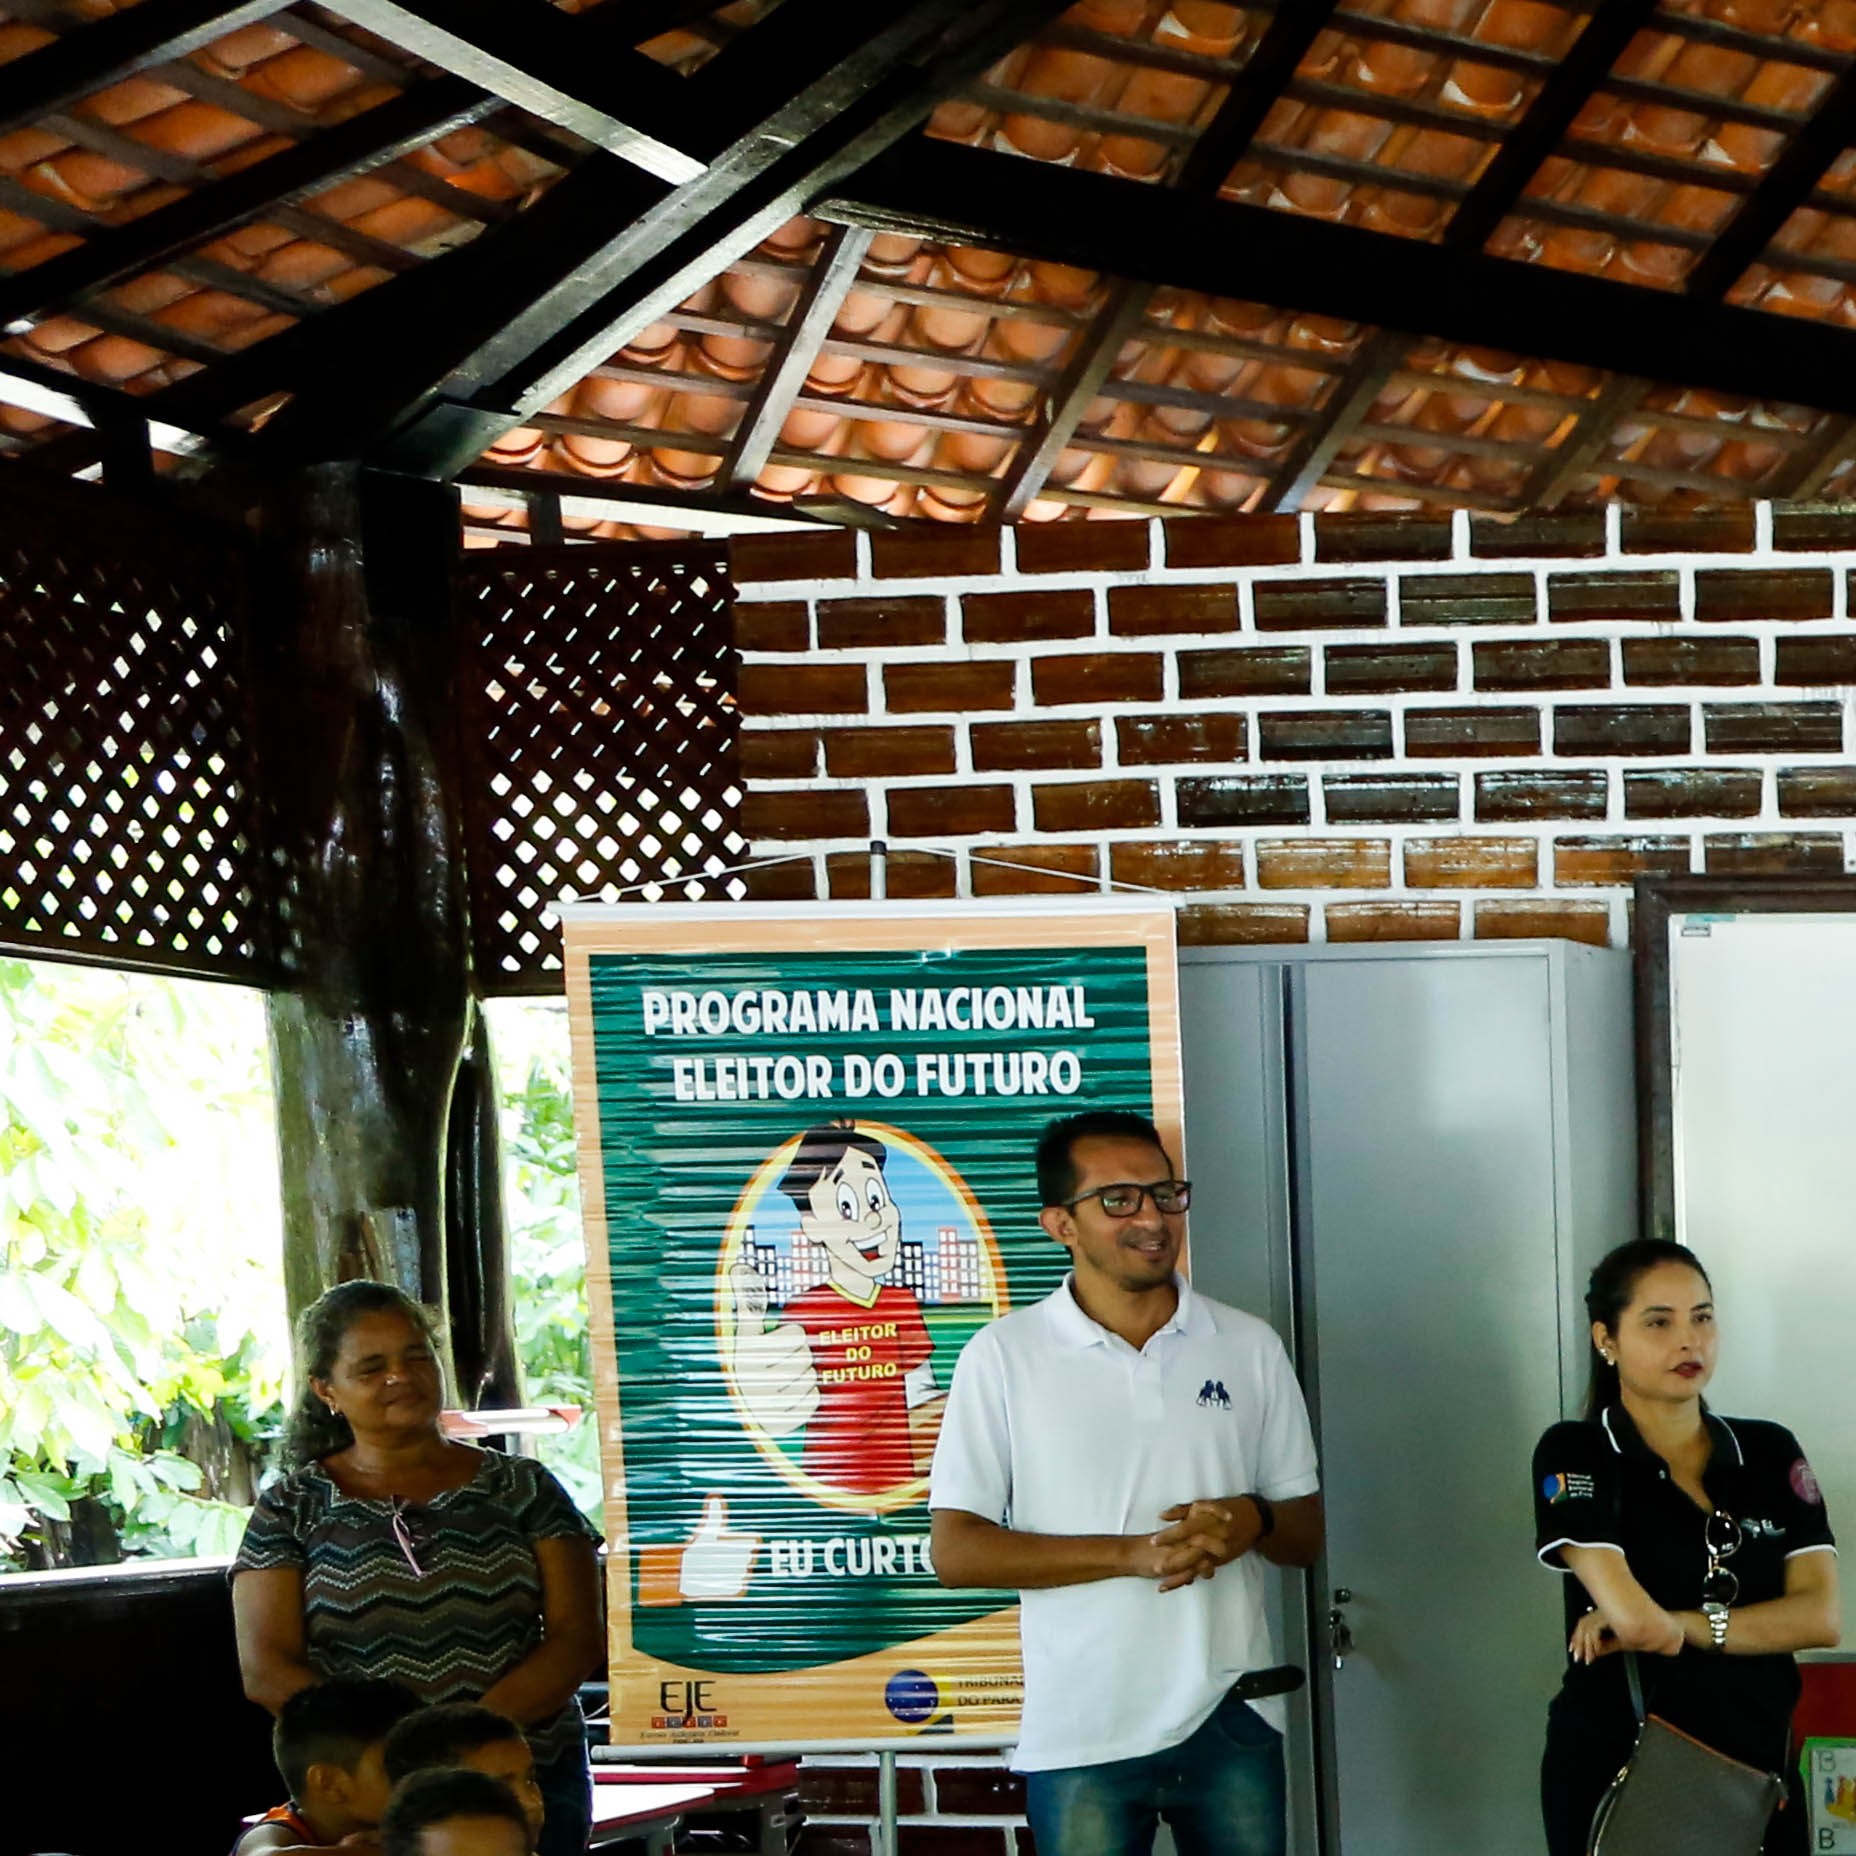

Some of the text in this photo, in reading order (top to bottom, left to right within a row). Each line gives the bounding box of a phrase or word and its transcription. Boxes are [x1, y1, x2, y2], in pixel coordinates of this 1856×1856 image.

[643, 986, 1095, 1035] PROGRAMA NACIONAL
[673, 1051, 1082, 1101] ELEITOR DO FUTURO
[819, 1322, 897, 1346] ELEITOR
[845, 1346, 872, 1362] DO
[822, 1363, 897, 1384] FUTURO
[770, 1539, 813, 1577] EU
[661, 1681, 717, 1726] EJE
[1818, 1827, 1835, 1850] B
